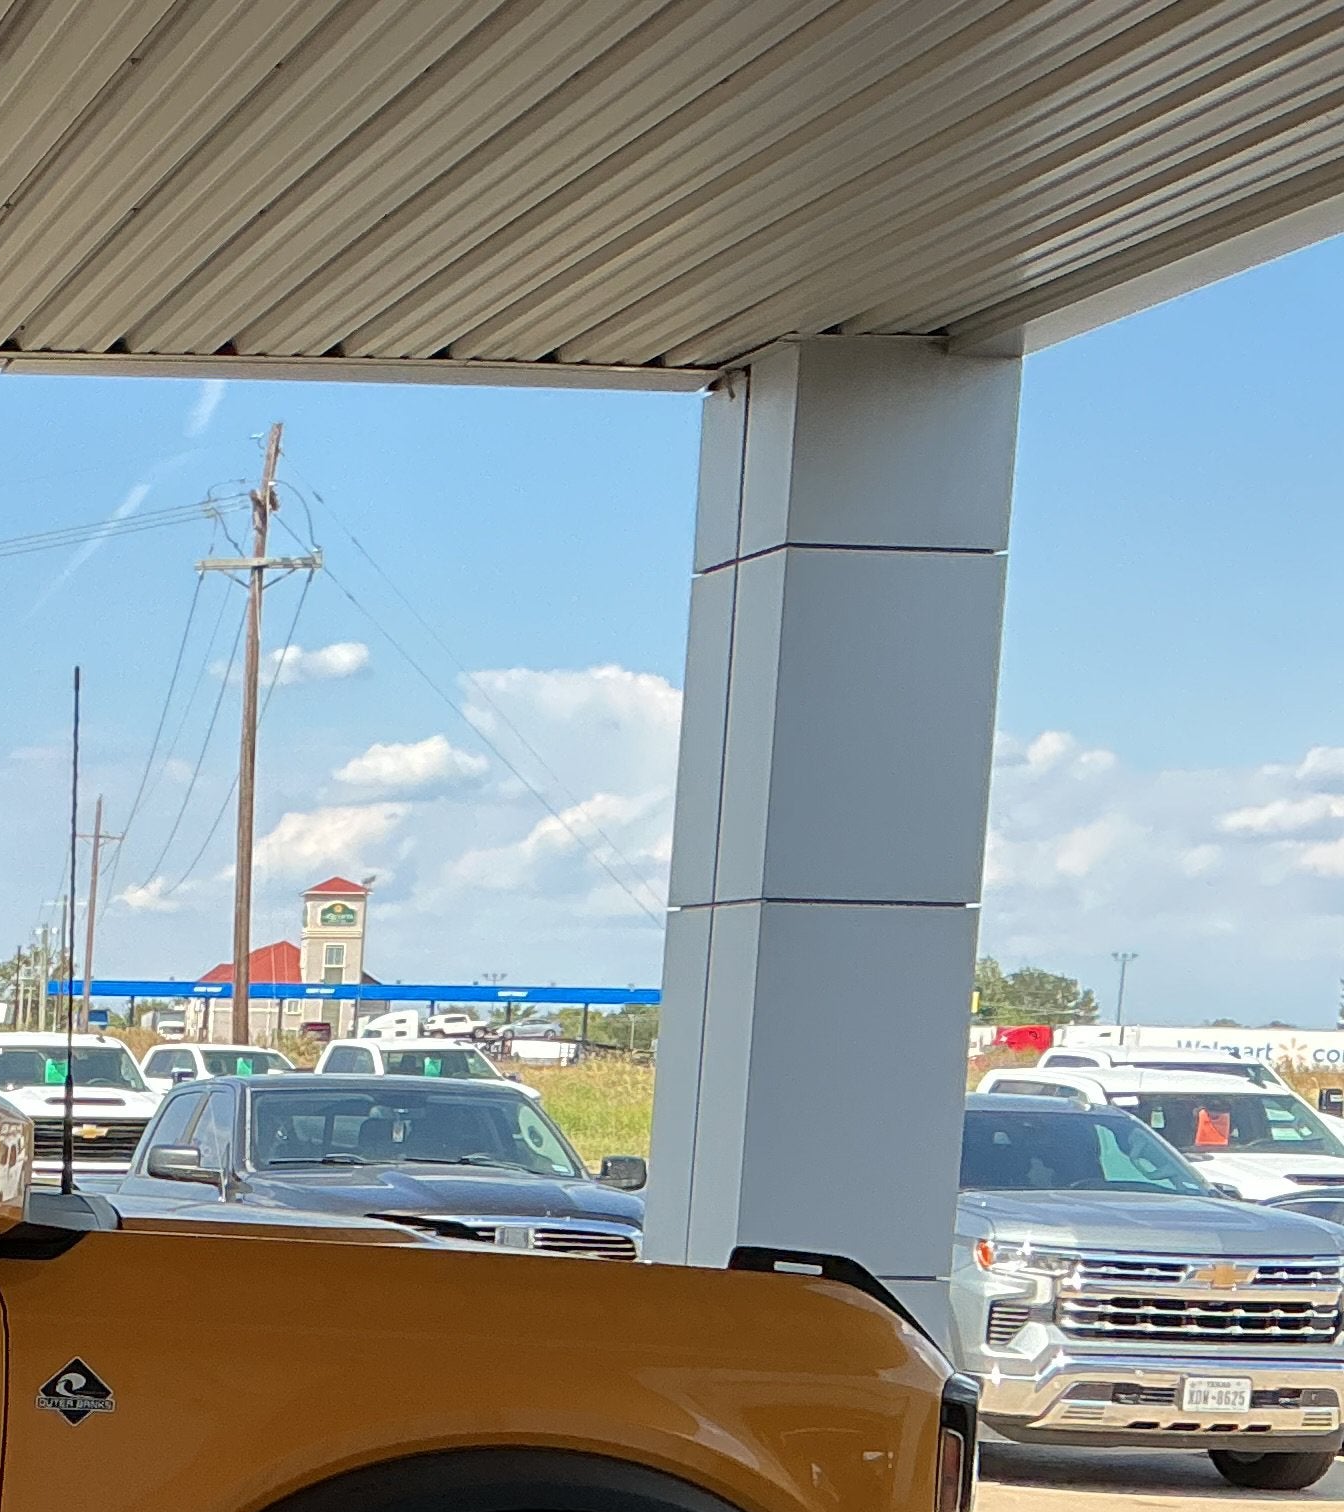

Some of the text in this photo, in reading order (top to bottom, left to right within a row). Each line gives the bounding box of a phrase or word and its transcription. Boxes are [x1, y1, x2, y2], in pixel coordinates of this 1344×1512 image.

[1176, 1040, 1344, 1063] Wlart co
[38, 1398, 112, 1409] OUTER BANKS
